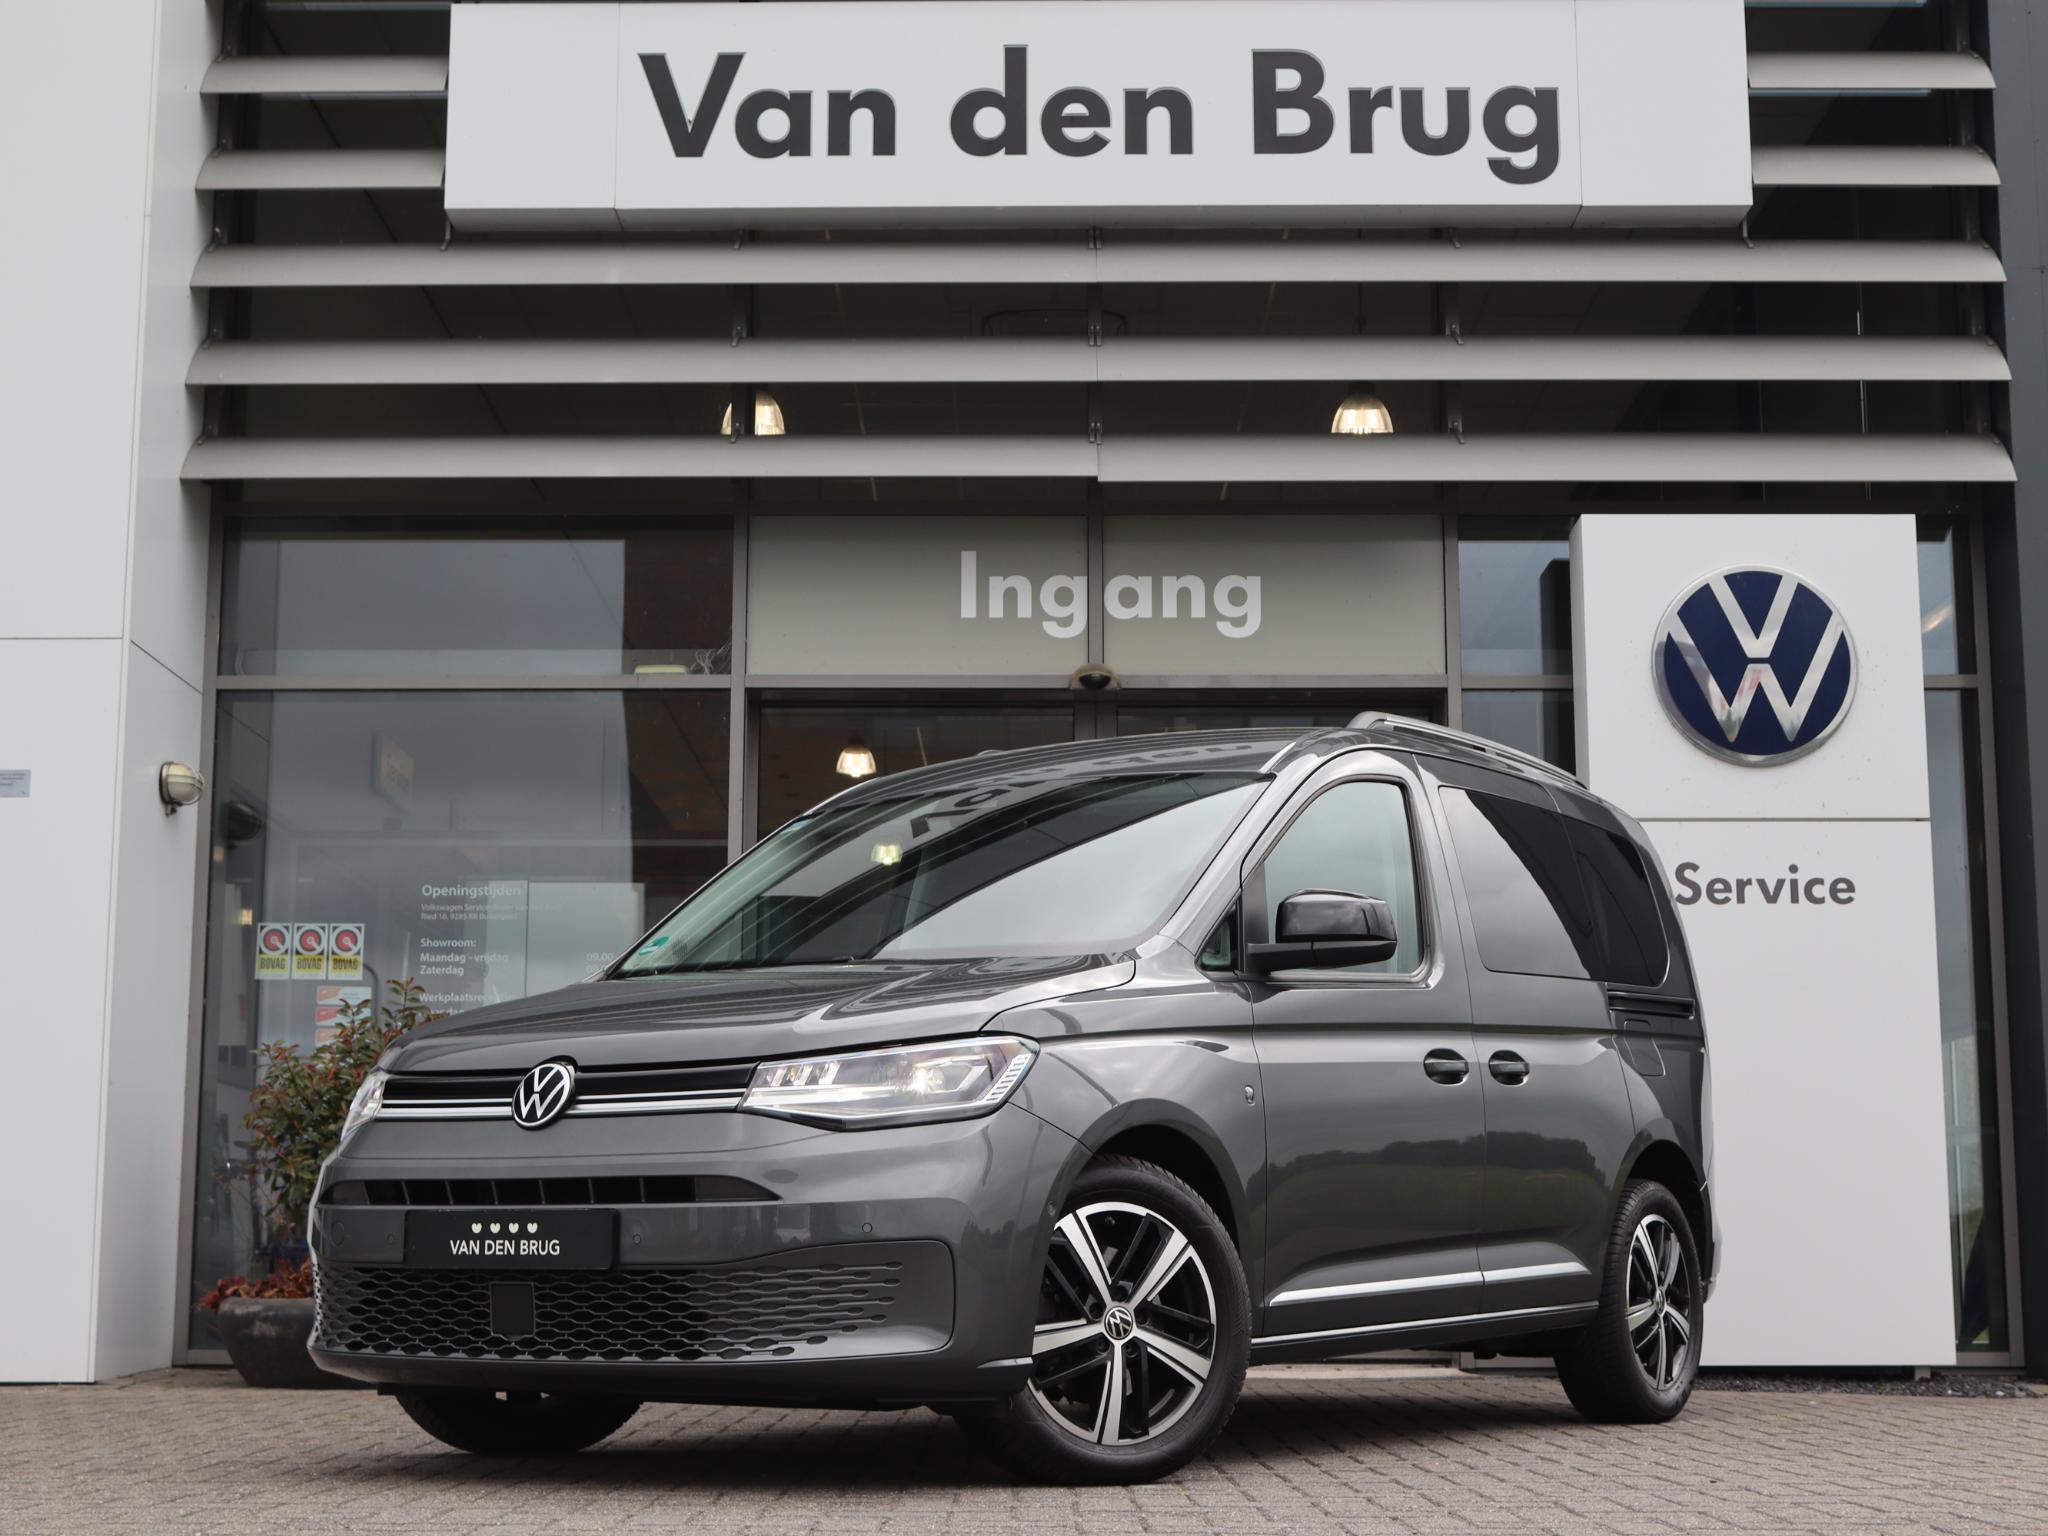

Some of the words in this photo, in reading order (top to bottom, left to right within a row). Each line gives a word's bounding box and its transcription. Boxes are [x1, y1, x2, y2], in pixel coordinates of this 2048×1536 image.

[638, 53, 895, 158] Van
[950, 45, 1193, 157] den
[1253, 49, 1559, 184] Brug
[961, 551, 1262, 638] Ingang
[1675, 862, 1856, 906] Service
[421, 884, 521, 899] Openingstijden
[420, 938, 477, 948] Showroom:
[260, 957, 286, 970] BOVAG
[297, 957, 322, 970] BOVAG
[332, 958, 358, 970] BOVAG
[420, 953, 466, 964] Maandag
[474, 953, 509, 964] vrijdag
[419, 966, 464, 976] Zaterdag
[450, 1240, 480, 1255] VAN
[485, 1240, 515, 1255] DEN
[520, 1240, 560, 1255] BRUG
